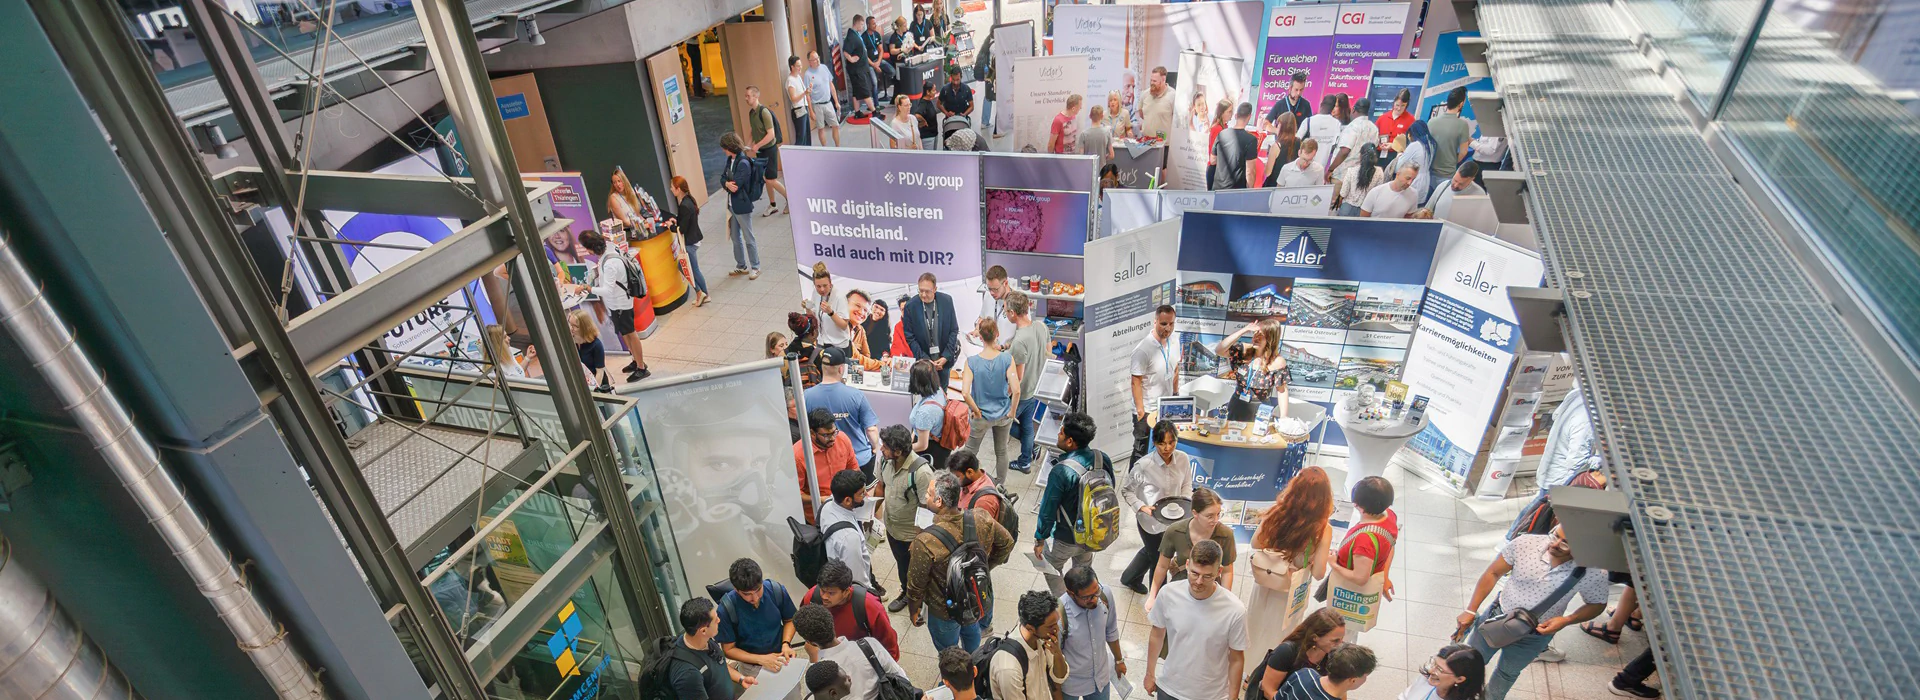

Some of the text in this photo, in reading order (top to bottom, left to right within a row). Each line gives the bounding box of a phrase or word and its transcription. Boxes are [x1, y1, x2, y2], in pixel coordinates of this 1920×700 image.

[1275, 15, 1296, 26] CGI
[1342, 13, 1366, 24] CGI
[1268, 54, 1318, 64] Für welchen
[1334, 51, 1390, 59] Karrieremöglichkeiten
[922, 69, 935, 81] MKT
[1267, 66, 1286, 76] Tech
[1264, 79, 1290, 90] schläg
[1262, 91, 1287, 101] Herz?
[899, 171, 963, 191] PDV.group
[806, 198, 943, 220] WIR digitalisieren
[810, 220, 908, 241] Deutschland.
[814, 243, 954, 266] Bald auch mit DIR?
[1275, 236, 1327, 265] saller
[1113, 251, 1151, 283] saller
[1454, 260, 1498, 295] saller
[1112, 319, 1152, 338] Abteilungen
[1417, 322, 1497, 364] Karrieremöglichkeiten
[1191, 462, 1212, 488] ller
[1213, 480, 1255, 489] für Immobilien!
[1335, 587, 1379, 605] Thüringen
